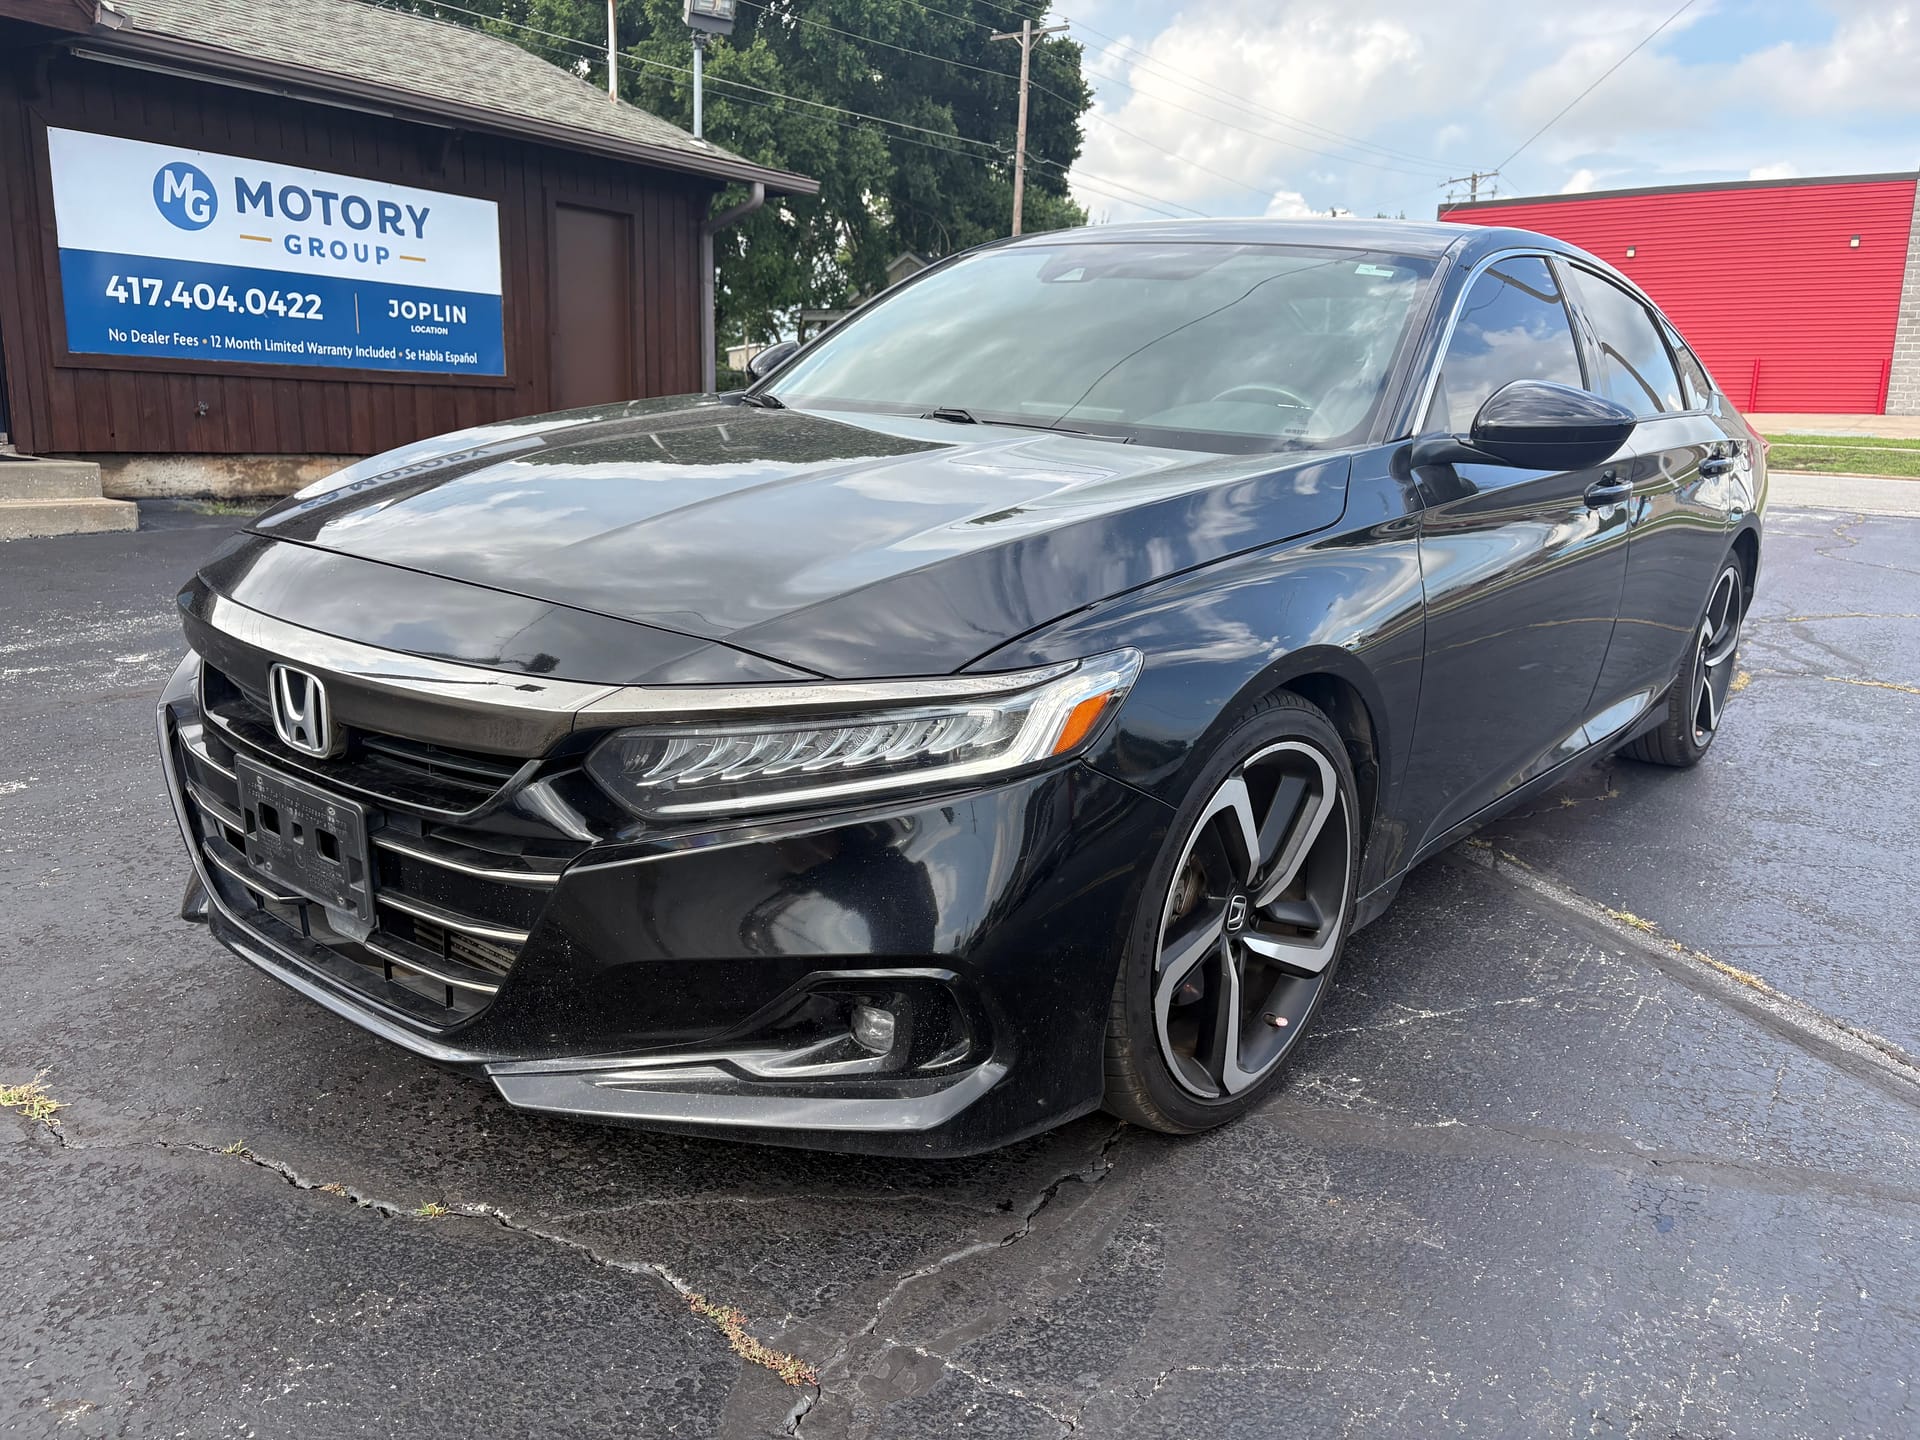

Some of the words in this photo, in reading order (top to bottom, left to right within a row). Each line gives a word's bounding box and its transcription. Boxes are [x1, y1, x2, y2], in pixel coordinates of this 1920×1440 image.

[162, 169, 210, 223] MG
[234, 176, 431, 239] MOTORY
[283, 234, 390, 265] GROUP
[105, 274, 324, 321] 417.404.0422
[388, 298, 468, 325] JOPLIN
[108, 327, 127, 342] No
[130, 329, 170, 345] Dealer
[172, 332, 199, 347] Fees
[410, 324, 449, 336] LOCATION
[209, 334, 222, 348] 12
[224, 335, 262, 351] Month
[264, 338, 305, 354] Limited
[306, 341, 353, 359] Warranty
[355, 345, 396, 360] Included
[405, 348, 417, 361] Se
[418, 349, 444, 363] Habla
[445, 350, 478, 366] Español
